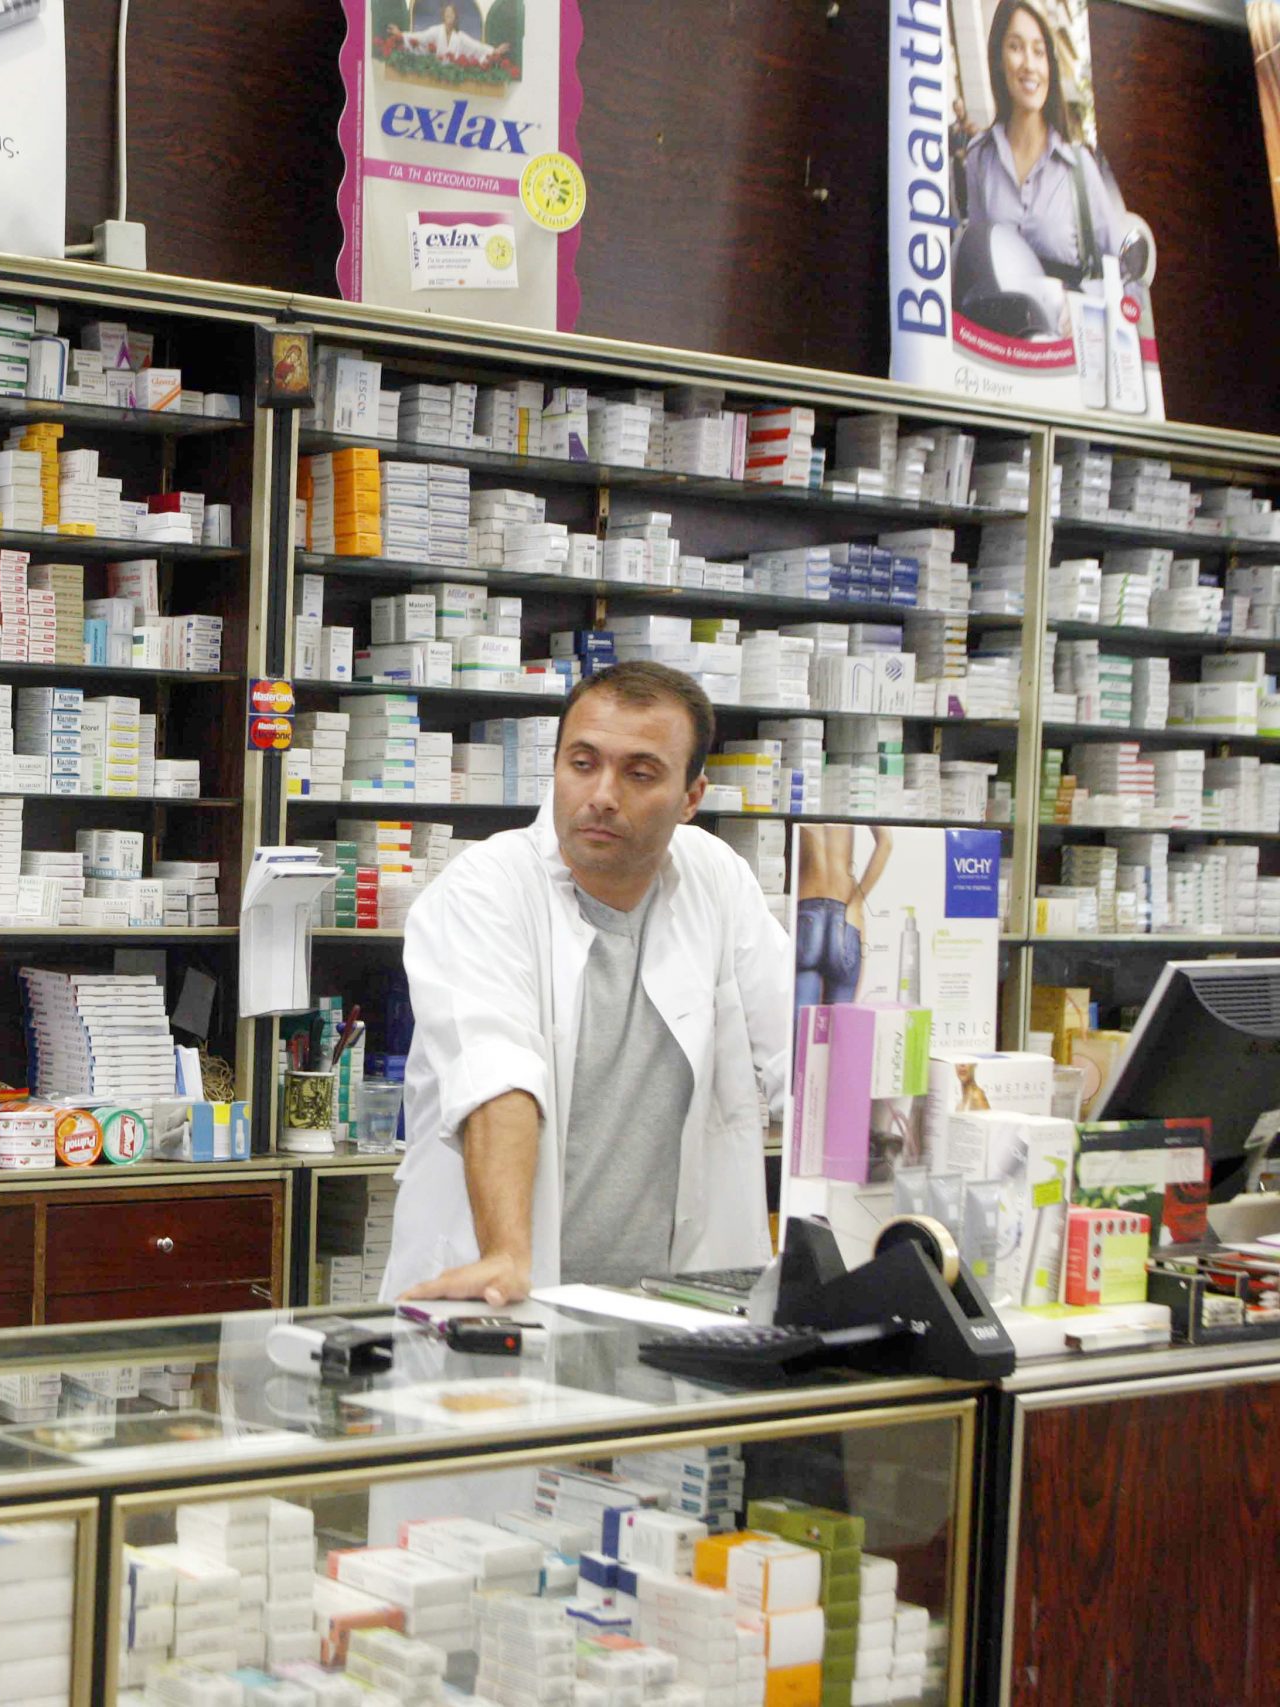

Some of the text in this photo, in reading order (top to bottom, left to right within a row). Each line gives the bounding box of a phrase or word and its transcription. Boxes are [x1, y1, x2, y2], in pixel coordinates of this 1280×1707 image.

[389, 165, 500, 192] ΓΙΑ ΤΗ ΔΥΣΚΟΙΛΙΟΤΗΤΑ
[953, 857, 993, 874] VICHY
